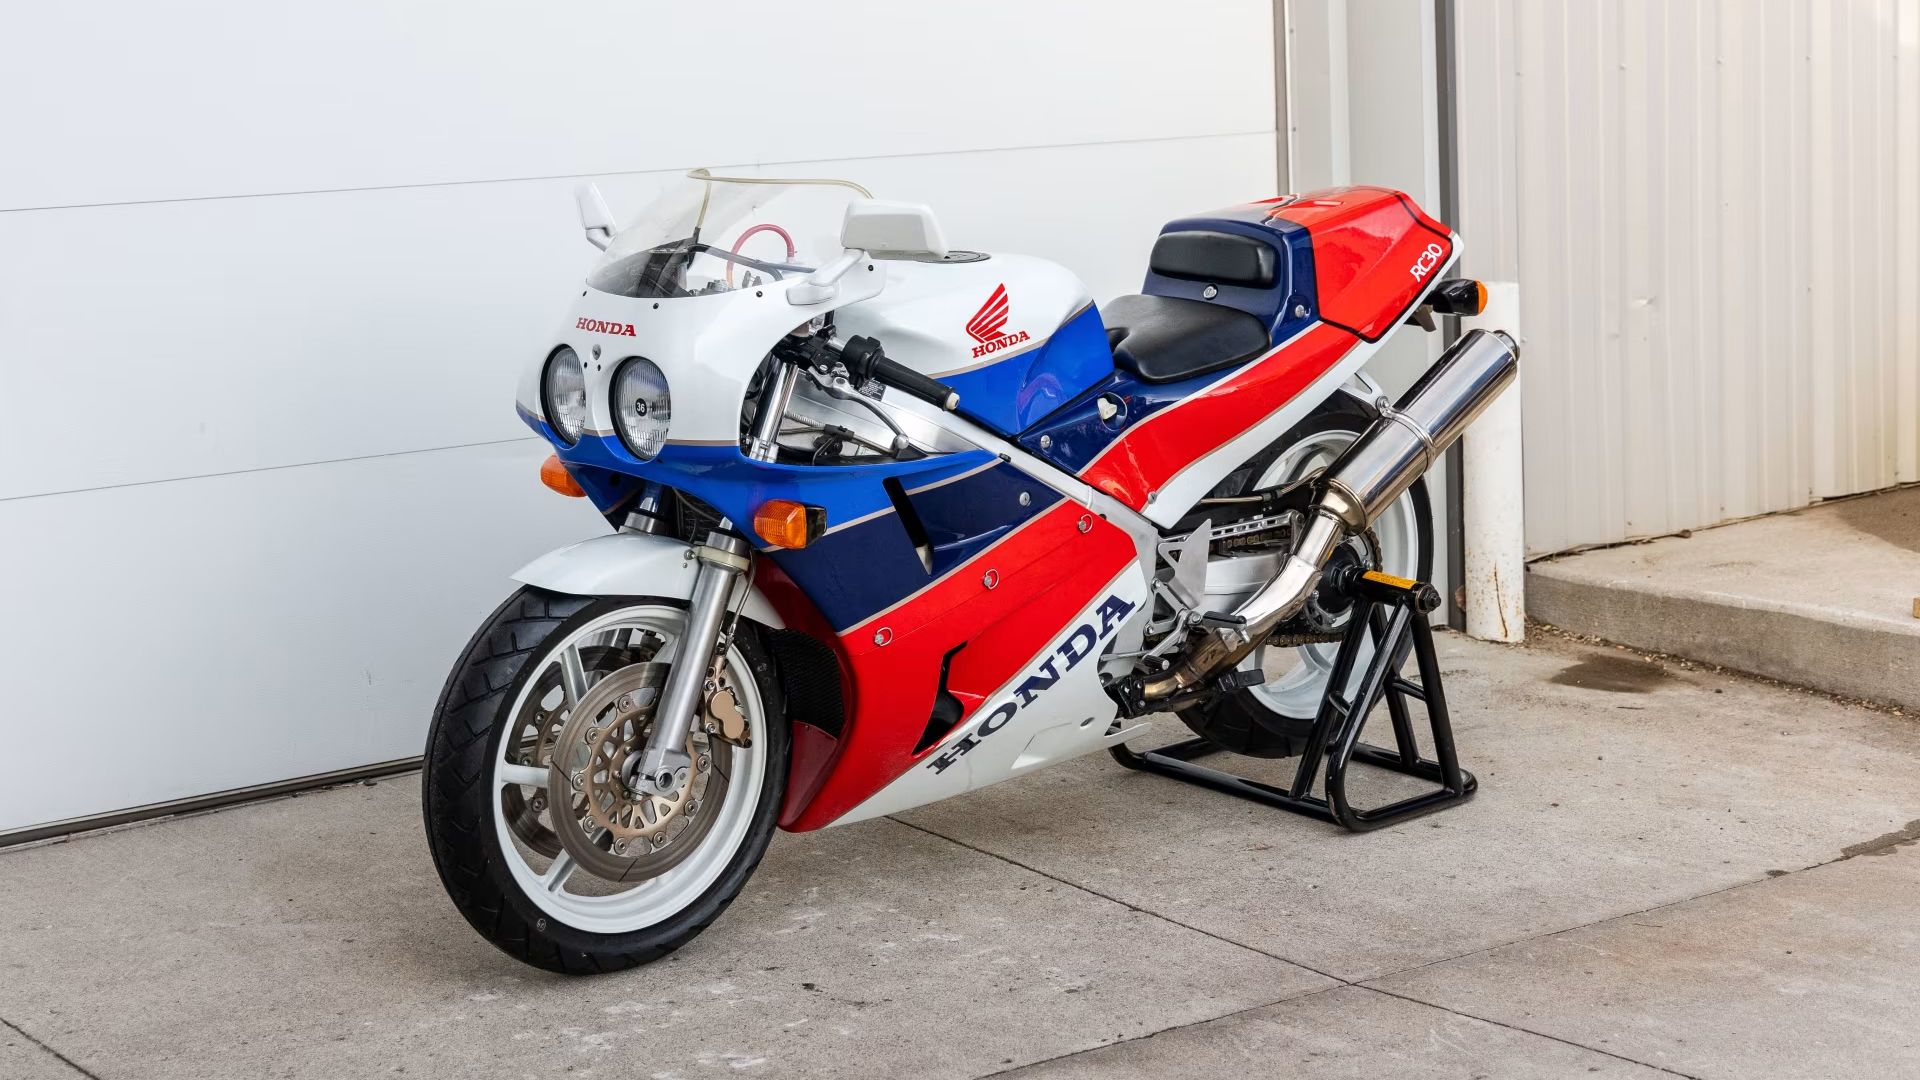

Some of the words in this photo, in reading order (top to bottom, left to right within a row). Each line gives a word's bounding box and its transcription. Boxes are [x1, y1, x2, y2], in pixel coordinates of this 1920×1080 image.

[1410, 243, 1443, 282] RC30
[576, 317, 636, 336] HONDA
[972, 331, 1030, 358] HONDA
[636, 402, 646, 413] 36
[926, 594, 1136, 775] HONDA
